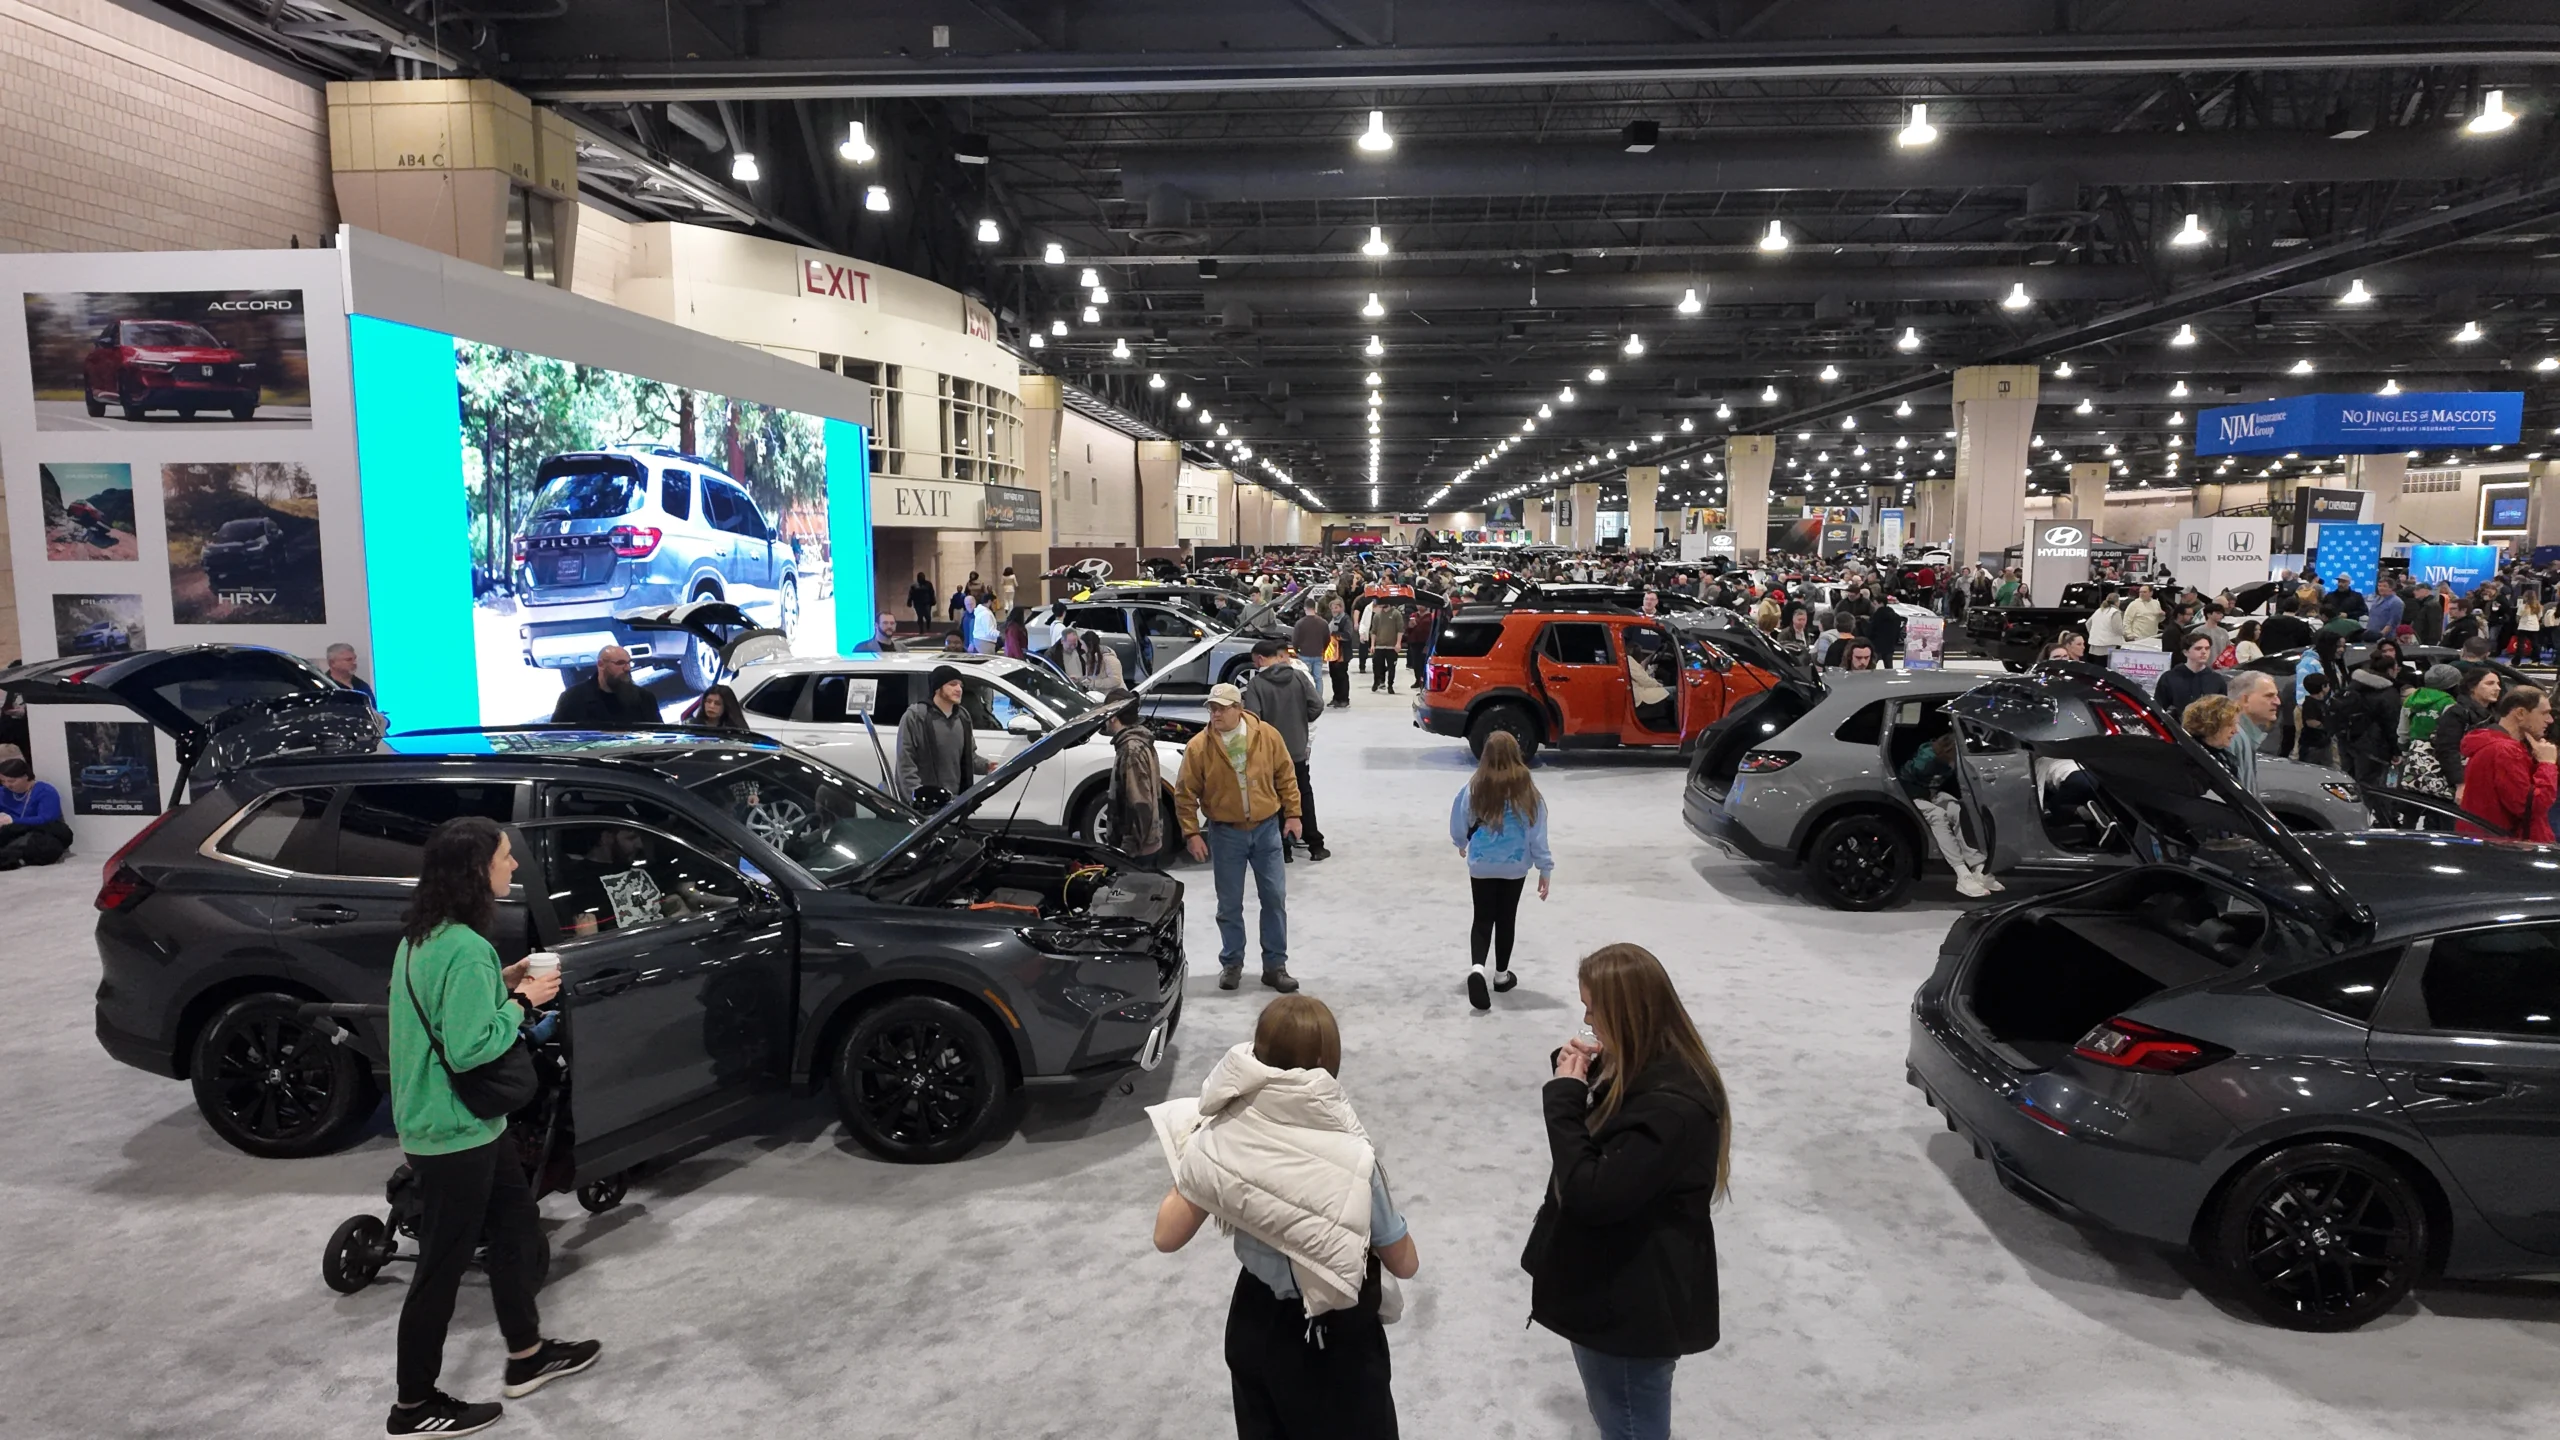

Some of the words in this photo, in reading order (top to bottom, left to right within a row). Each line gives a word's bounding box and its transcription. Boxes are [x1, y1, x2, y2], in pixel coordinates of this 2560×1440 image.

[398, 154, 426, 167] AB4
[804, 259, 871, 304] EXIT
[207, 300, 292, 311] ACCORD
[2363, 410, 2418, 426] JINGLES
[2431, 409, 2497, 423] MASCOTS
[2219, 412, 2255, 445] NJM
[2256, 411, 2287, 423] Insurance
[2255, 426, 2275, 438] Group
[894, 487, 952, 517] EXIT
[539, 536, 591, 549] PILOT
[2037, 548, 2088, 558] HYUNDAI
[2216, 554, 2263, 562] HONDA
[2424, 565, 2454, 585] NJM
[80, 598, 117, 606] PILOT
[218, 592, 277, 604] HR-V
